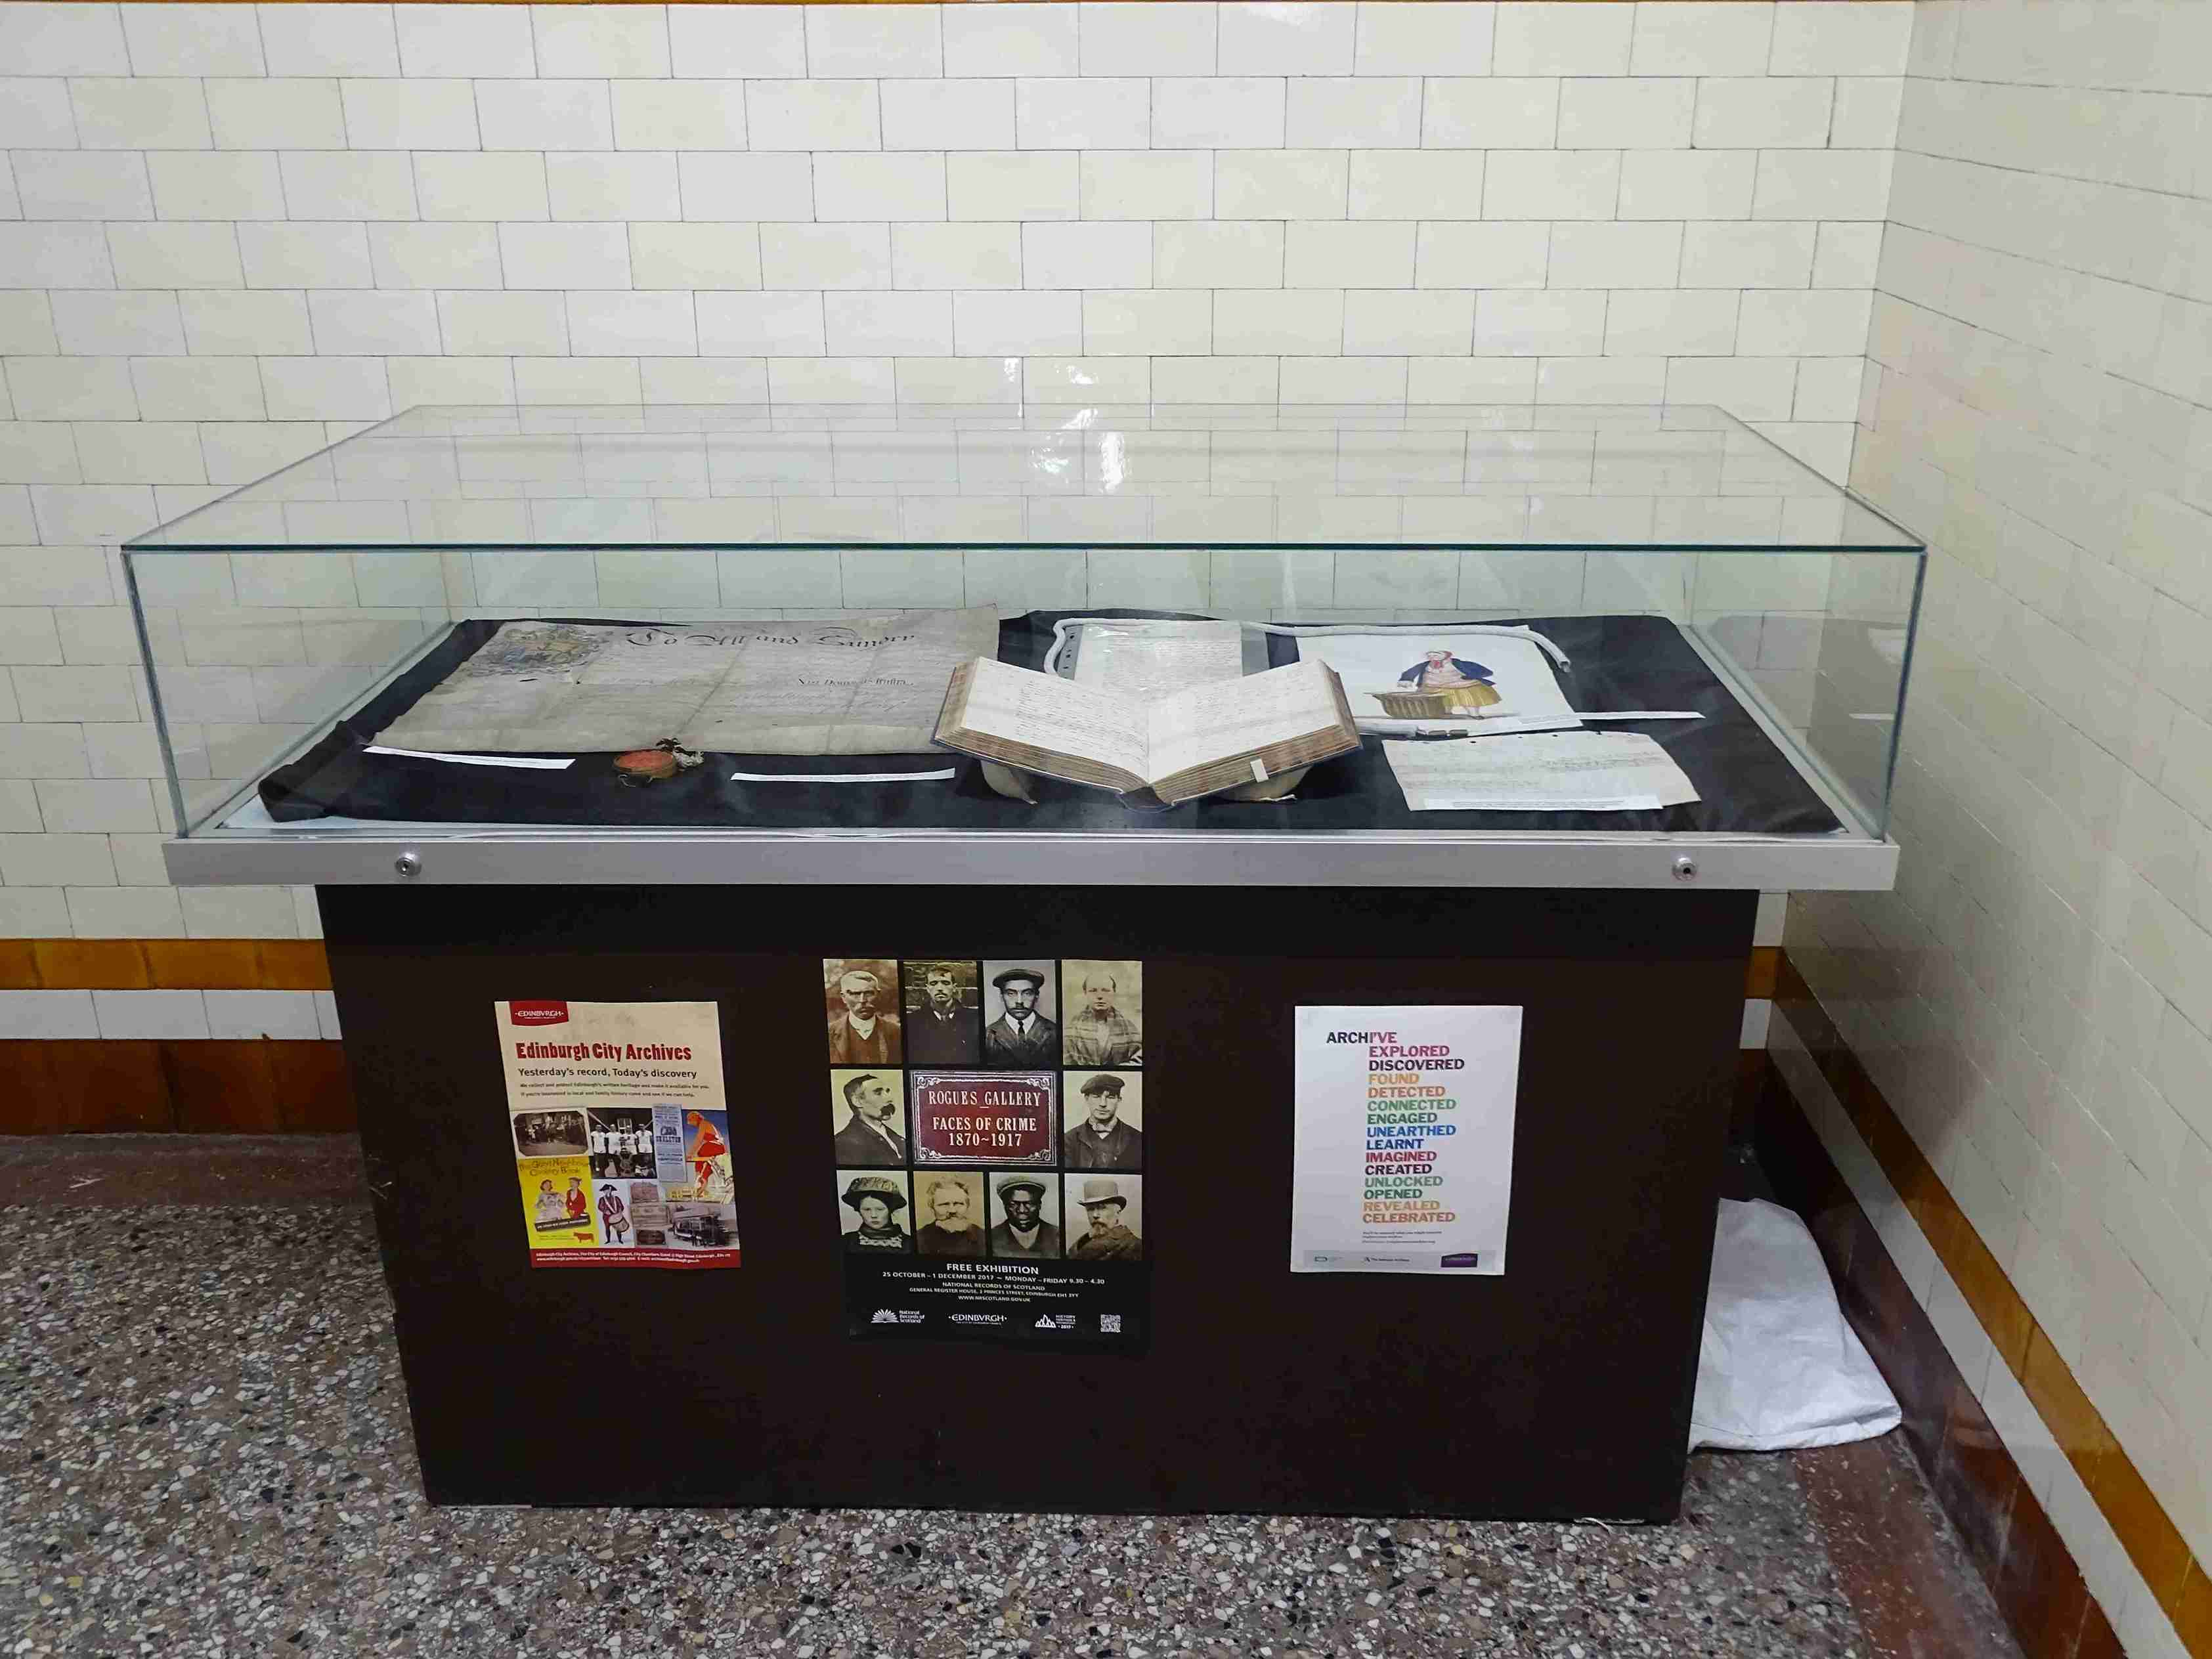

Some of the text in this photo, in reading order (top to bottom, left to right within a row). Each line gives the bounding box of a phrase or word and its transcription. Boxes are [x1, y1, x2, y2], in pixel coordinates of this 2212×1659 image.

[515, 1041, 691, 1062] Edinburgh City Archives
[1369, 1045, 1450, 1058] EXPLORED
[1368, 1059, 1465, 1071] DISCOVERED
[518, 1067, 697, 1079] Yesterday's record, Today's discovery
[1369, 1073, 1419, 1085] FOUND
[928, 1090, 1041, 1106] ROGUES GALLERY
[1368, 1086, 1445, 1098] DETECTED
[1367, 1099, 1456, 1111] CONNECTED
[932, 1117, 1037, 1131] FACES OF CRIME
[1367, 1113, 1437, 1125] ENGAGED
[1367, 1125, 1456, 1137] UNEARTHED
[1366, 1139, 1423, 1150] LEARNT
[1366, 1152, 1437, 1163] IMAGINED
[1365, 1164, 1432, 1175] CREATED
[1365, 1176, 1443, 1188] UNLOCKED
[1364, 1189, 1422, 1199] OPENED
[1363, 1200, 1440, 1212] REVEALED
[1362, 1212, 1456, 1224] CELEBRATED
[946, 1263, 1039, 1275] FREE EXHIBITION
[951, 1314, 1005, 1322] EDINBVRGH
